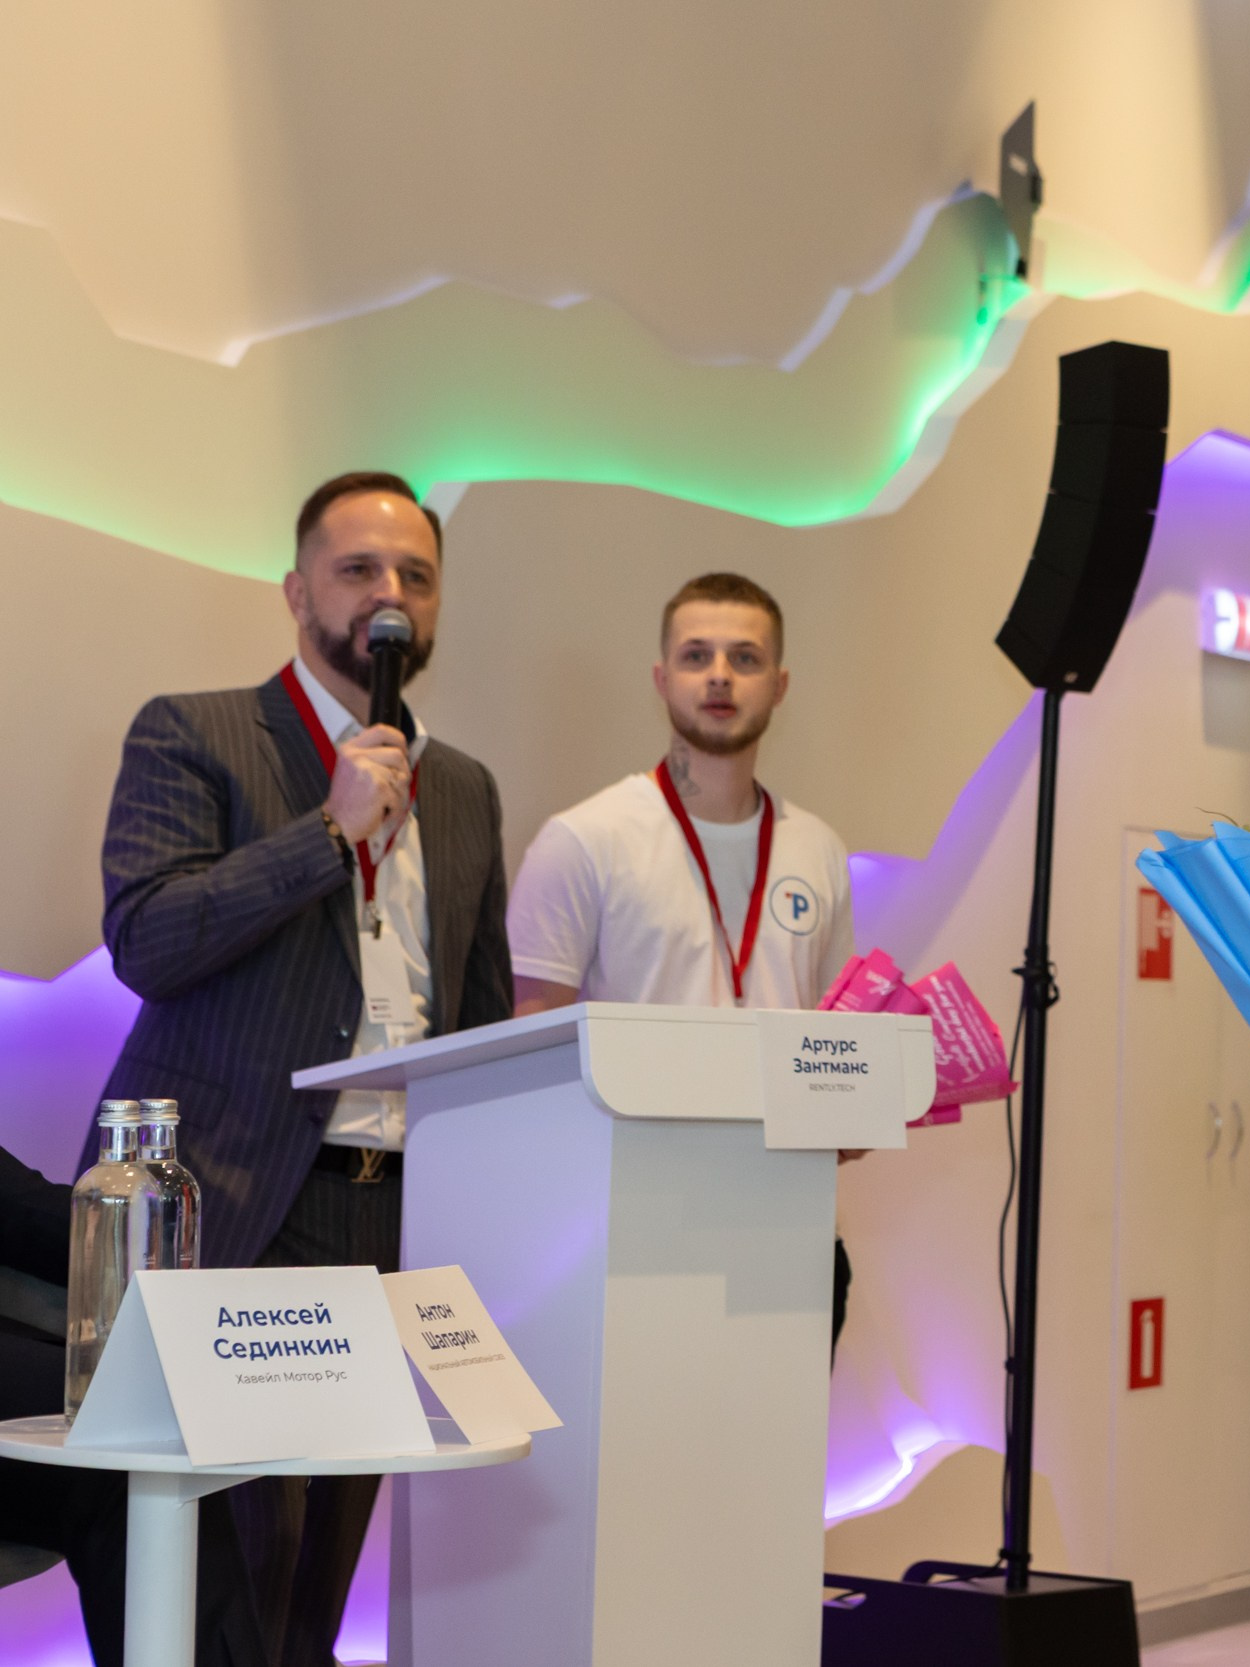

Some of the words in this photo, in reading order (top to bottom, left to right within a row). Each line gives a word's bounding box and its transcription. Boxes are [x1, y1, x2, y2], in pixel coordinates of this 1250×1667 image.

[801, 1036, 858, 1055] Артурс
[793, 1058, 869, 1075] Зантманс
[217, 1302, 332, 1328] Алексей
[415, 1303, 456, 1322] Антон
[421, 1329, 480, 1350] Шапарин
[213, 1338, 351, 1361] Сединкин
[235, 1372, 281, 1385] Хавейл
[283, 1371, 323, 1383] Мотор
[325, 1369, 348, 1382] Рус
